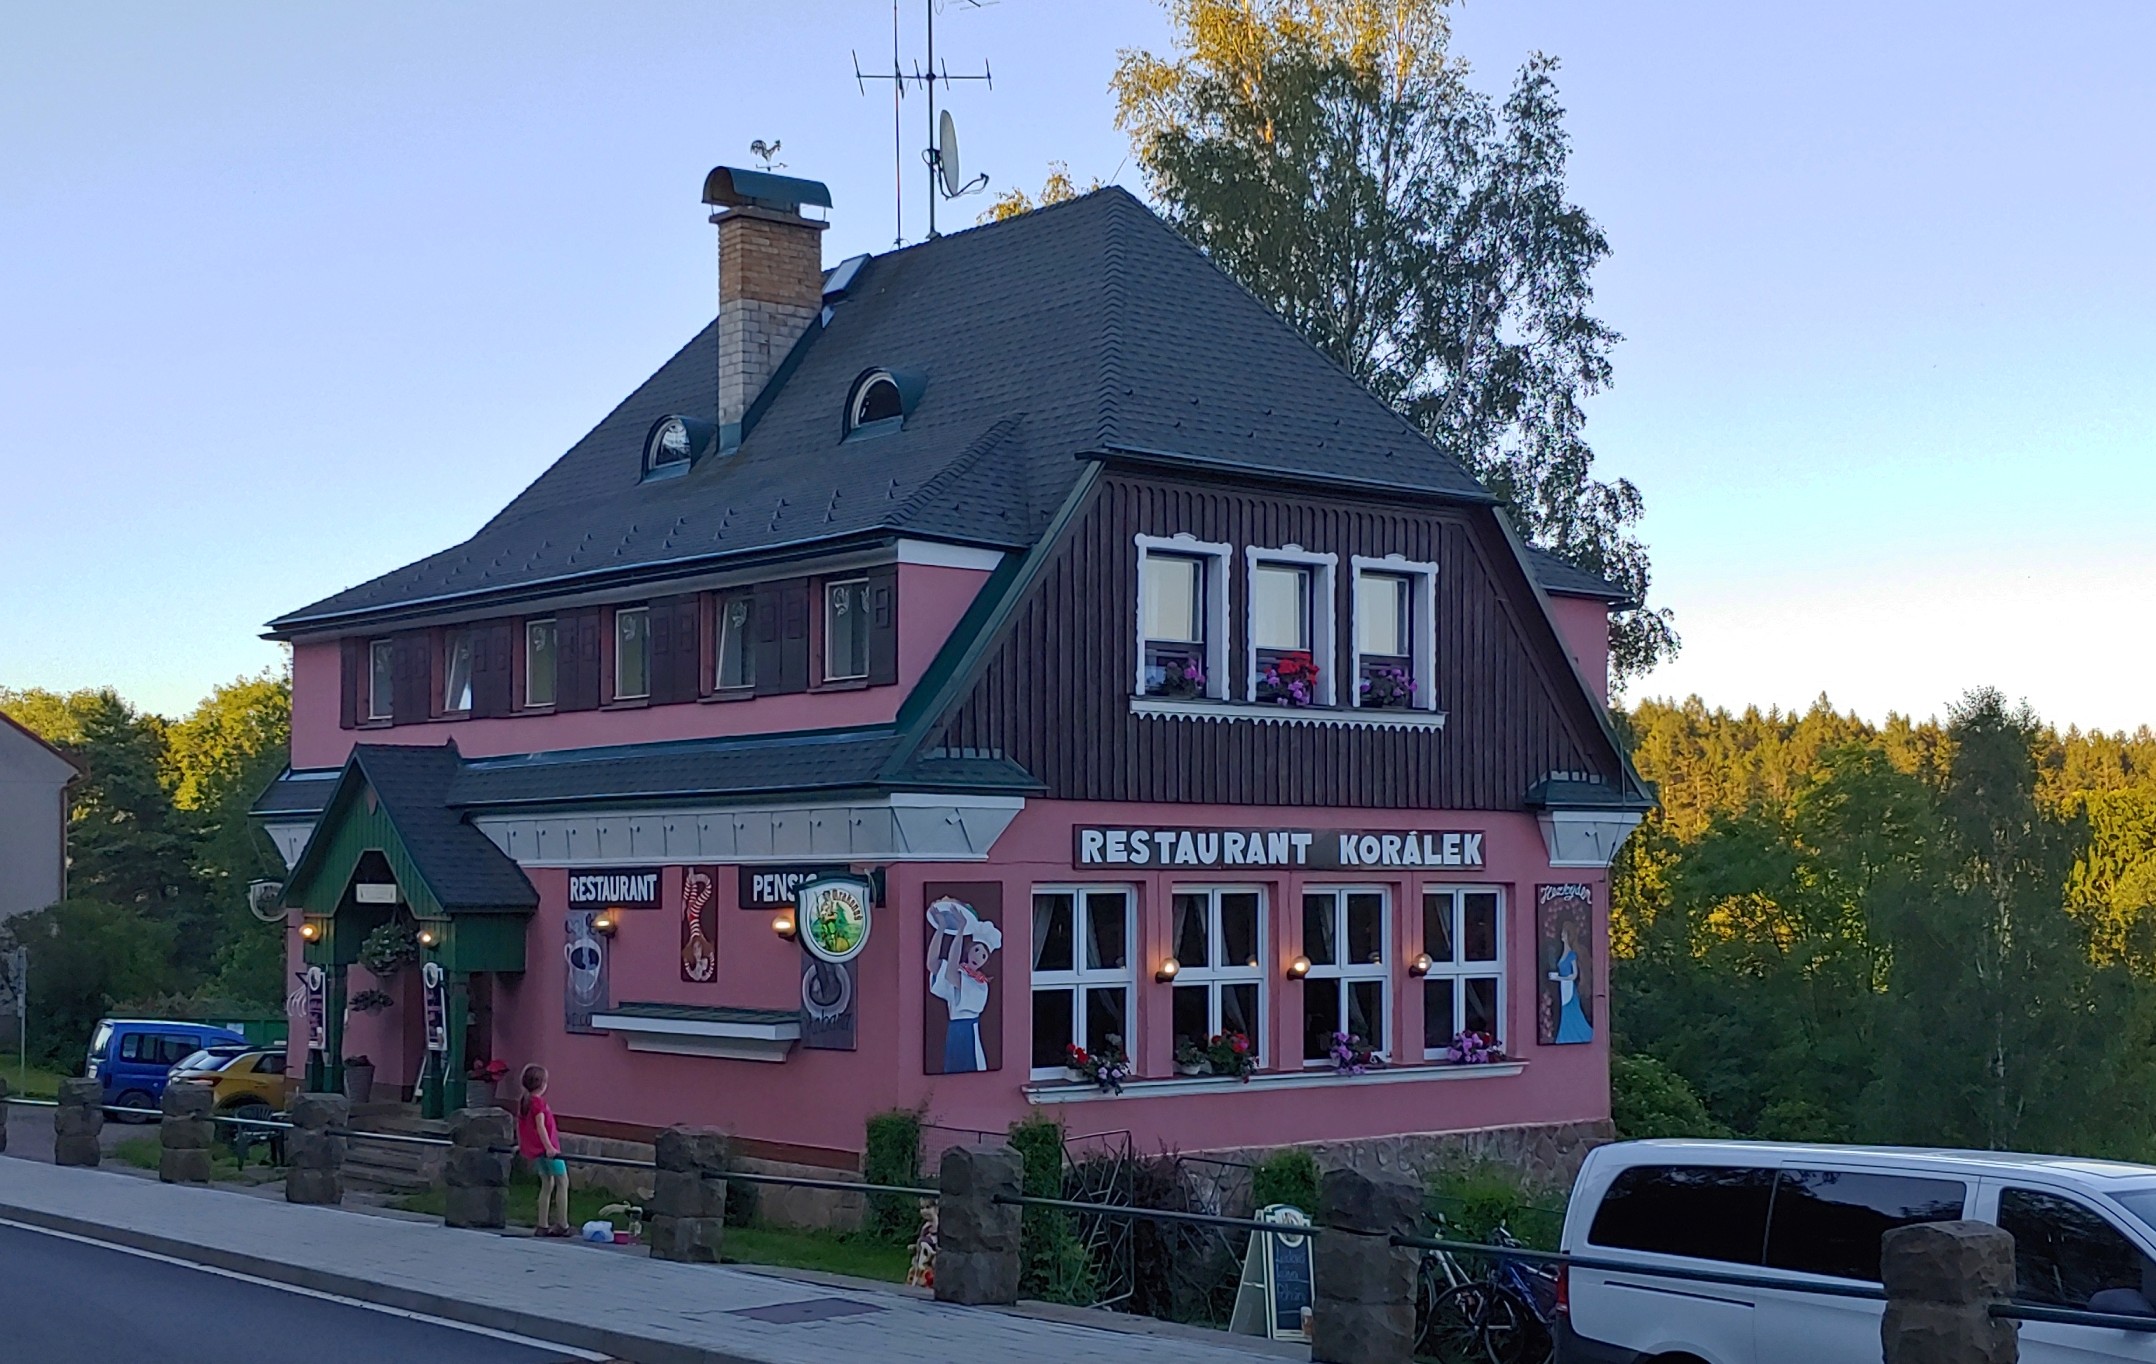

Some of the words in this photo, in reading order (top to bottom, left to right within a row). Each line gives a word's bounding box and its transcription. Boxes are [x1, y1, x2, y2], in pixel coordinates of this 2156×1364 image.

[1081, 829, 1312, 865] RESTAURANT
[1339, 830, 1483, 866] KORÁLEK
[570, 874, 657, 902] RESTAURANT
